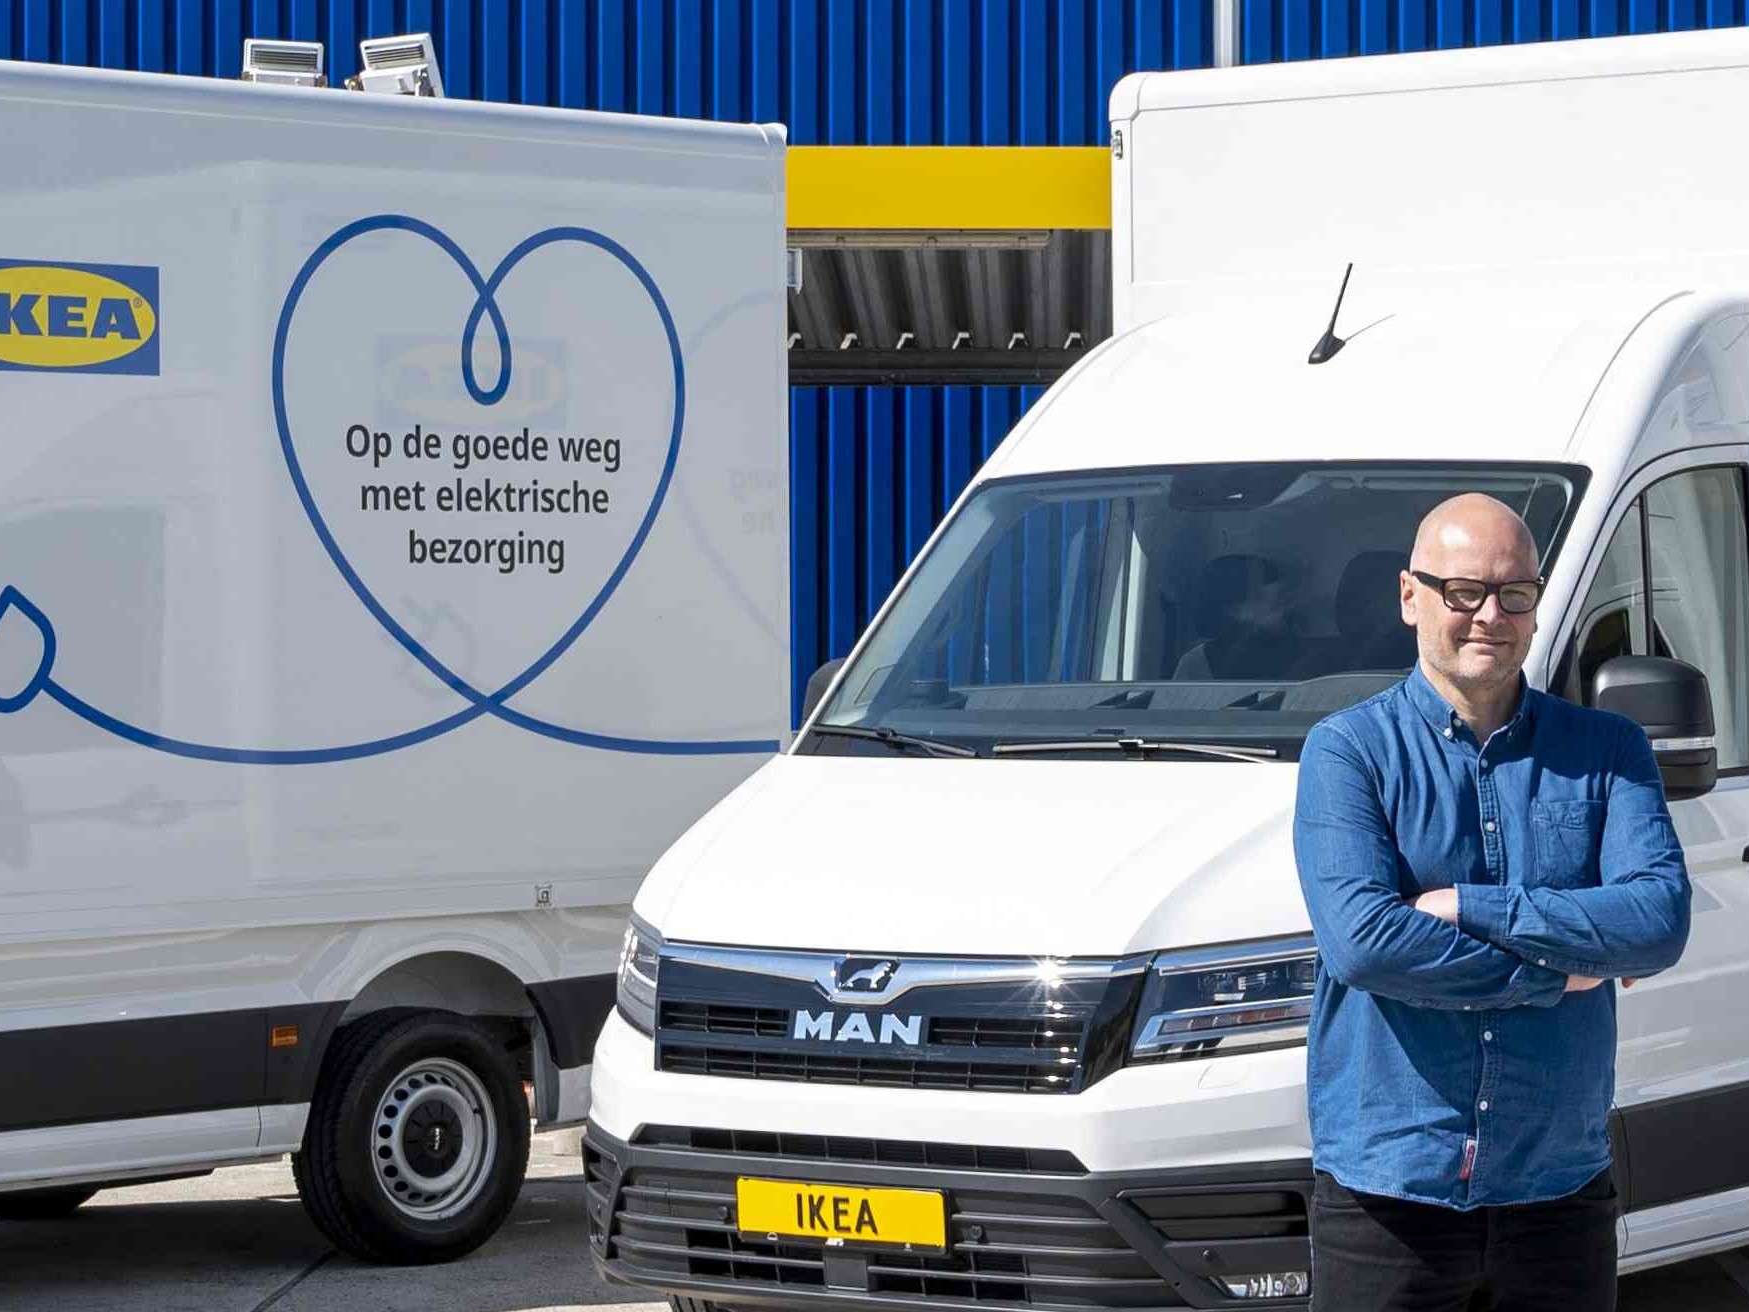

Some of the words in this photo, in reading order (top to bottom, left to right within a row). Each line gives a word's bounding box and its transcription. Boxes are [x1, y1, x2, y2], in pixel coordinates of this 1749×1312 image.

[346, 424, 392, 468] Op
[403, 424, 442, 460] de
[452, 427, 549, 470] goede
[558, 436, 622, 473] weg
[361, 481, 426, 512] met
[436, 477, 610, 514] elektrische
[408, 529, 566, 575] bezorging
[794, 1009, 922, 1045] MAN
[797, 1193, 878, 1235] IKEA
